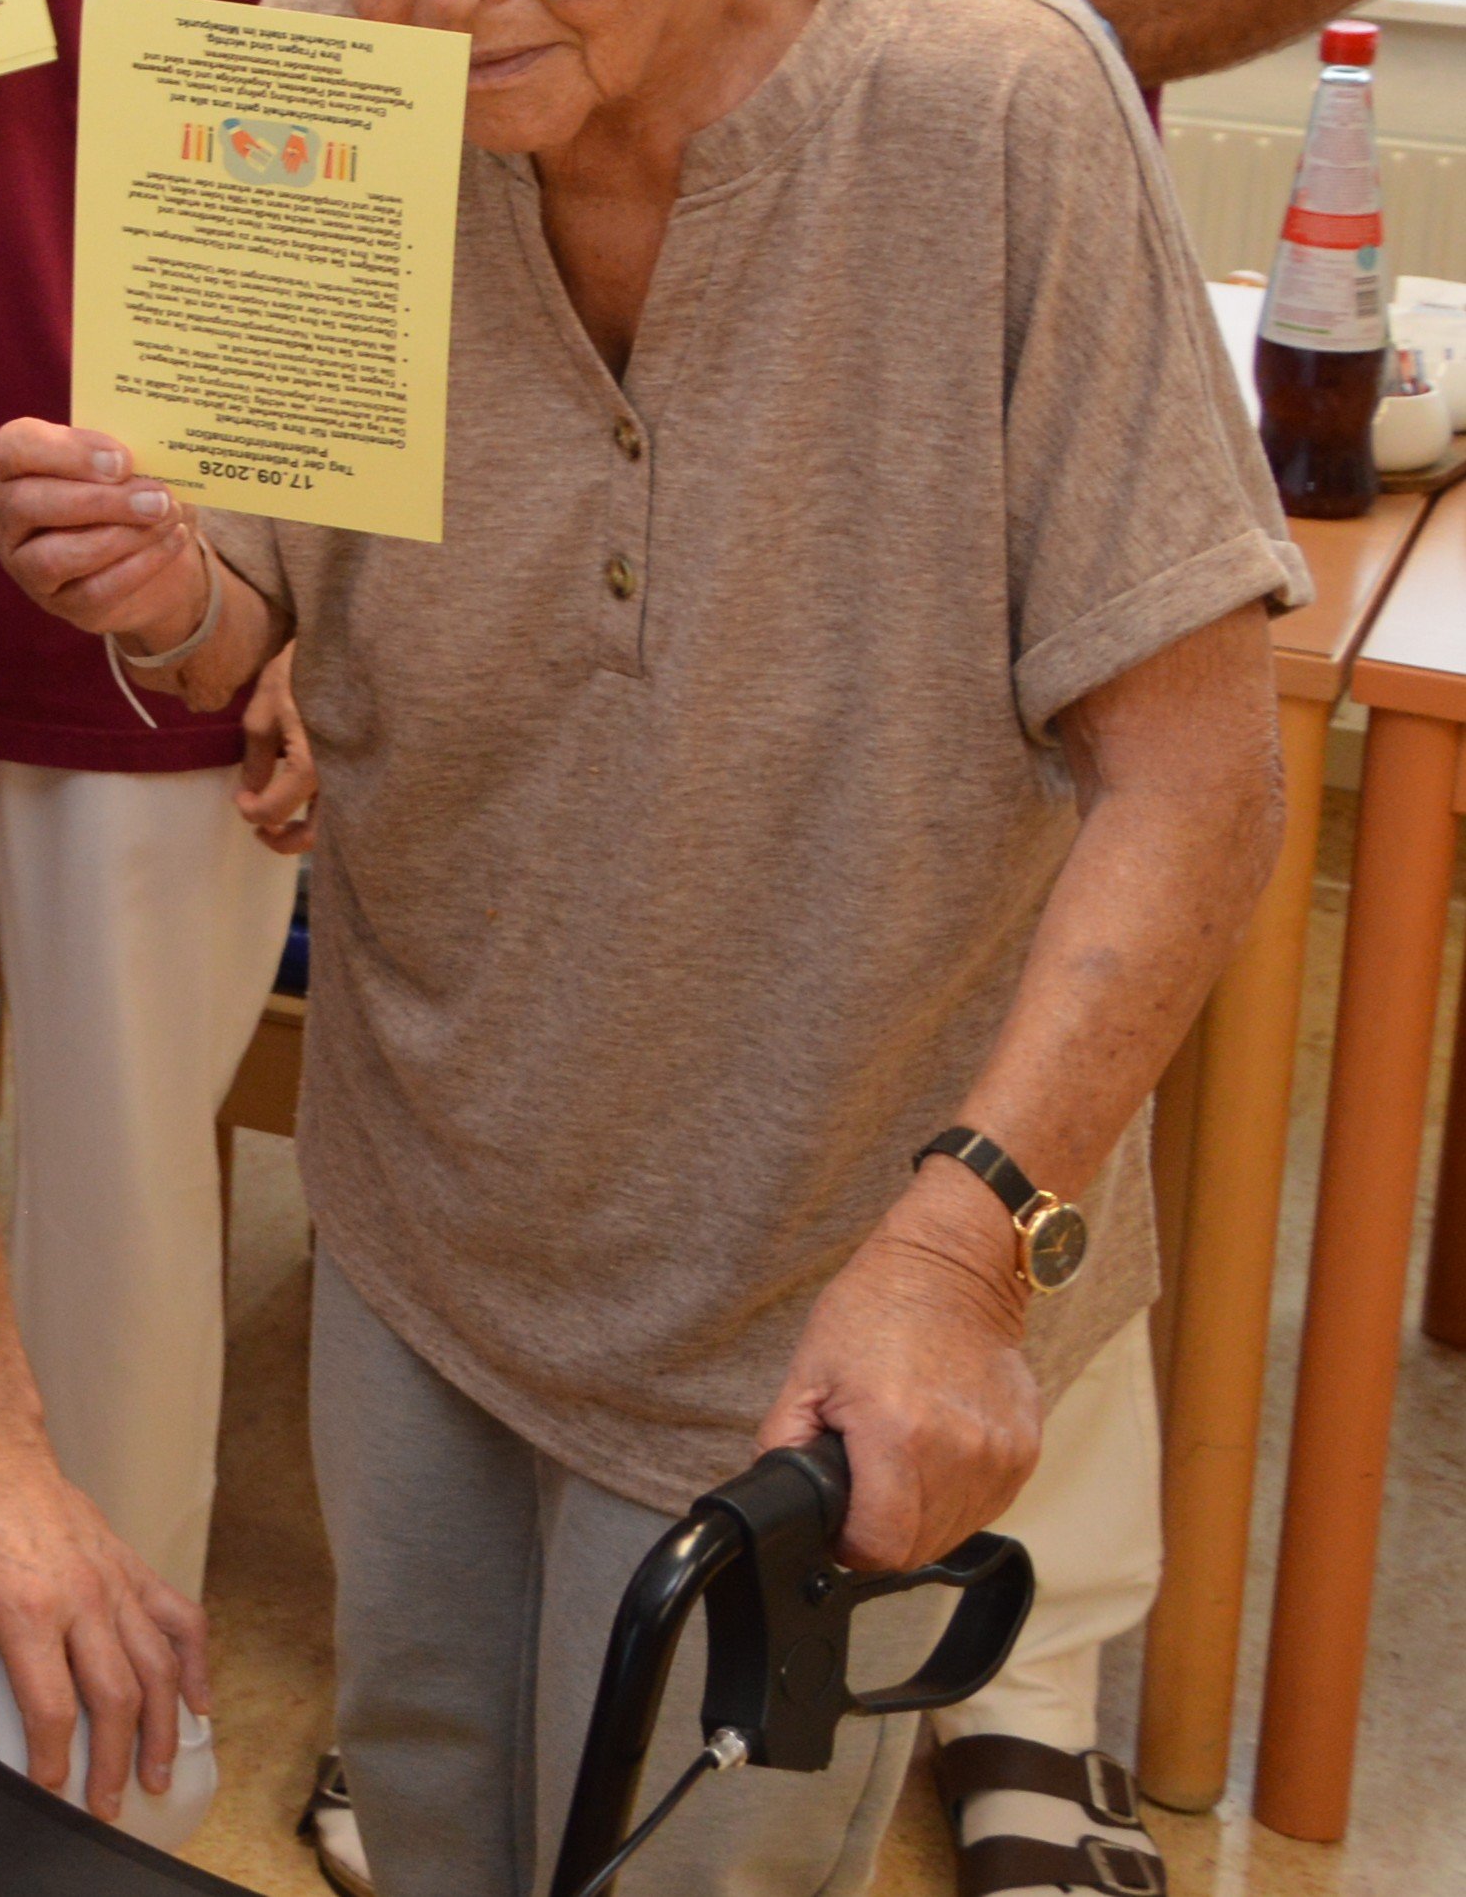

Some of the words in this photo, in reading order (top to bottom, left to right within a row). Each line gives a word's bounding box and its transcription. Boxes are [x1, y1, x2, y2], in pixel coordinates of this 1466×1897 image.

[167, 440, 298, 468] Patientensicherheit
[185, 428, 327, 457] Patienteninformation
[199, 460, 313, 489] 17.09.2026
[302, 460, 325, 470] der
[328, 461, 354, 476] Tag
